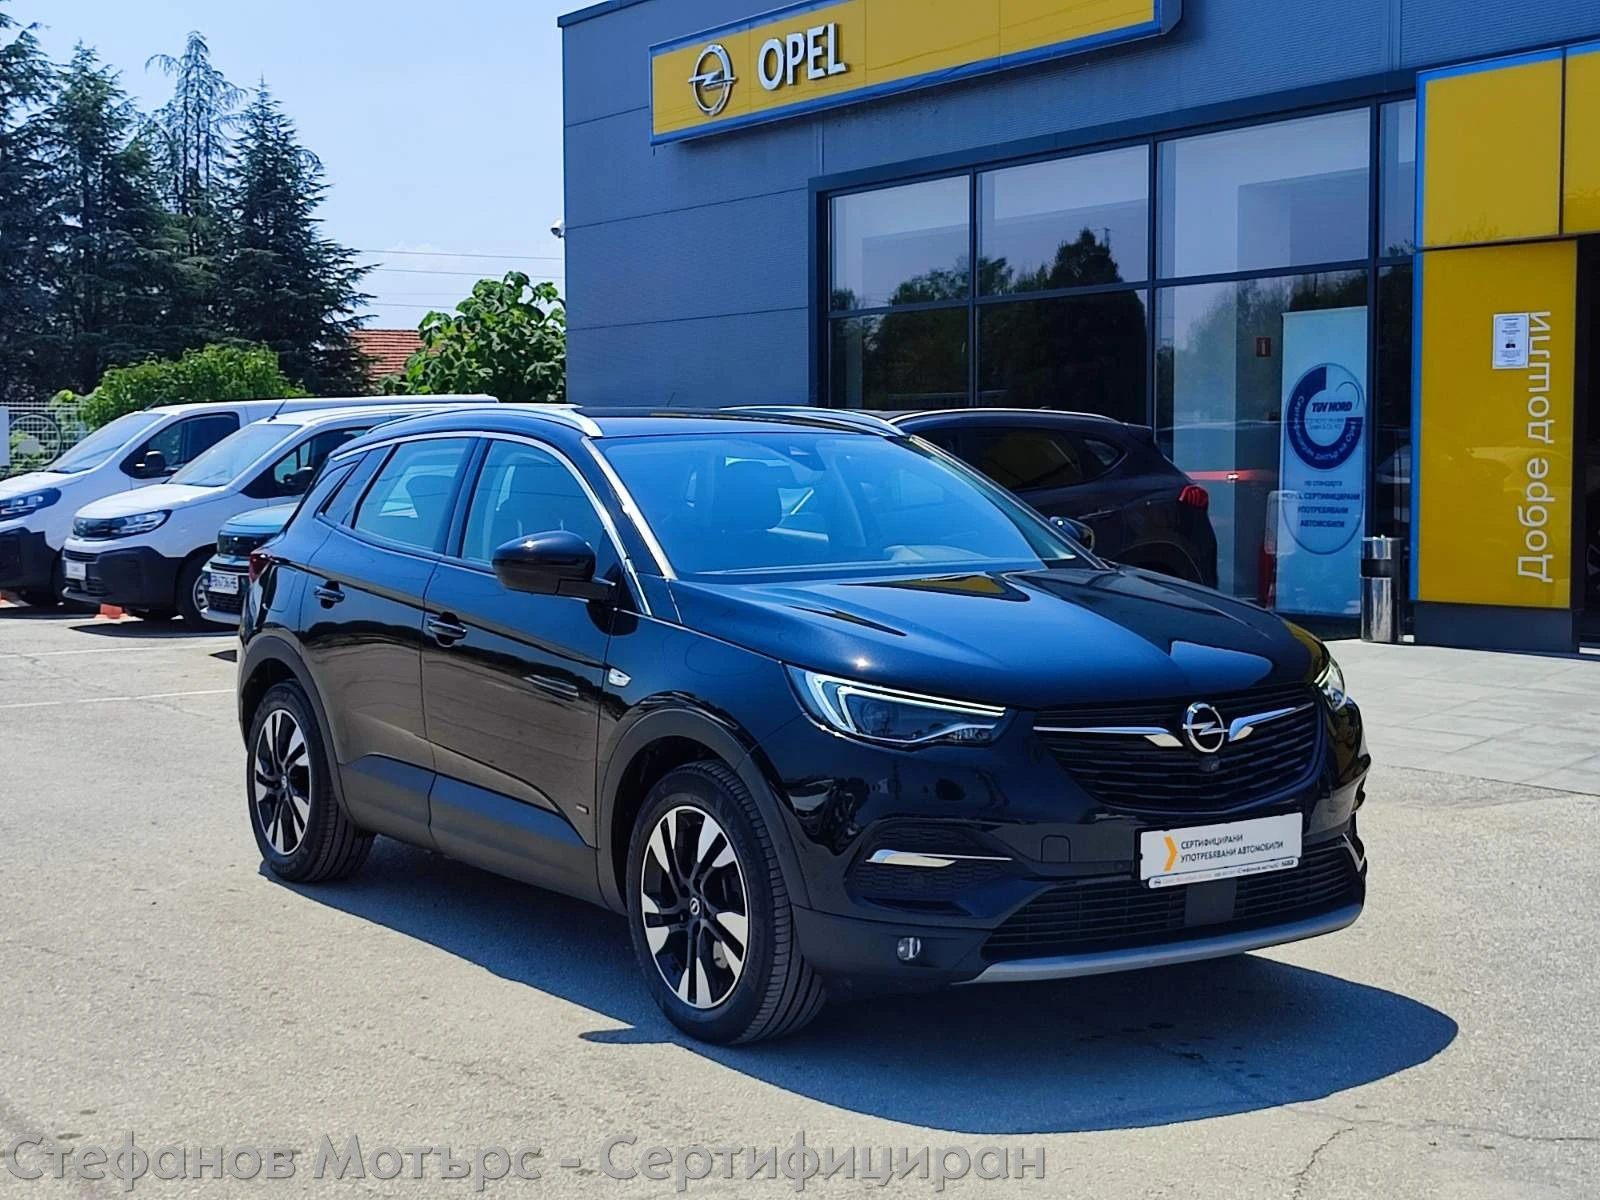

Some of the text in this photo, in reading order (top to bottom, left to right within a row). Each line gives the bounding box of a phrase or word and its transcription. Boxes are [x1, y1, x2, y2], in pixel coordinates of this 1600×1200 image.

[757, 22, 848, 91] OPEL
[1329, 401, 1353, 412] NORD
[1517, 311, 1555, 583] Добре дошли
[1180, 833, 1243, 850] СЕРТИФИЦИРАНИ
